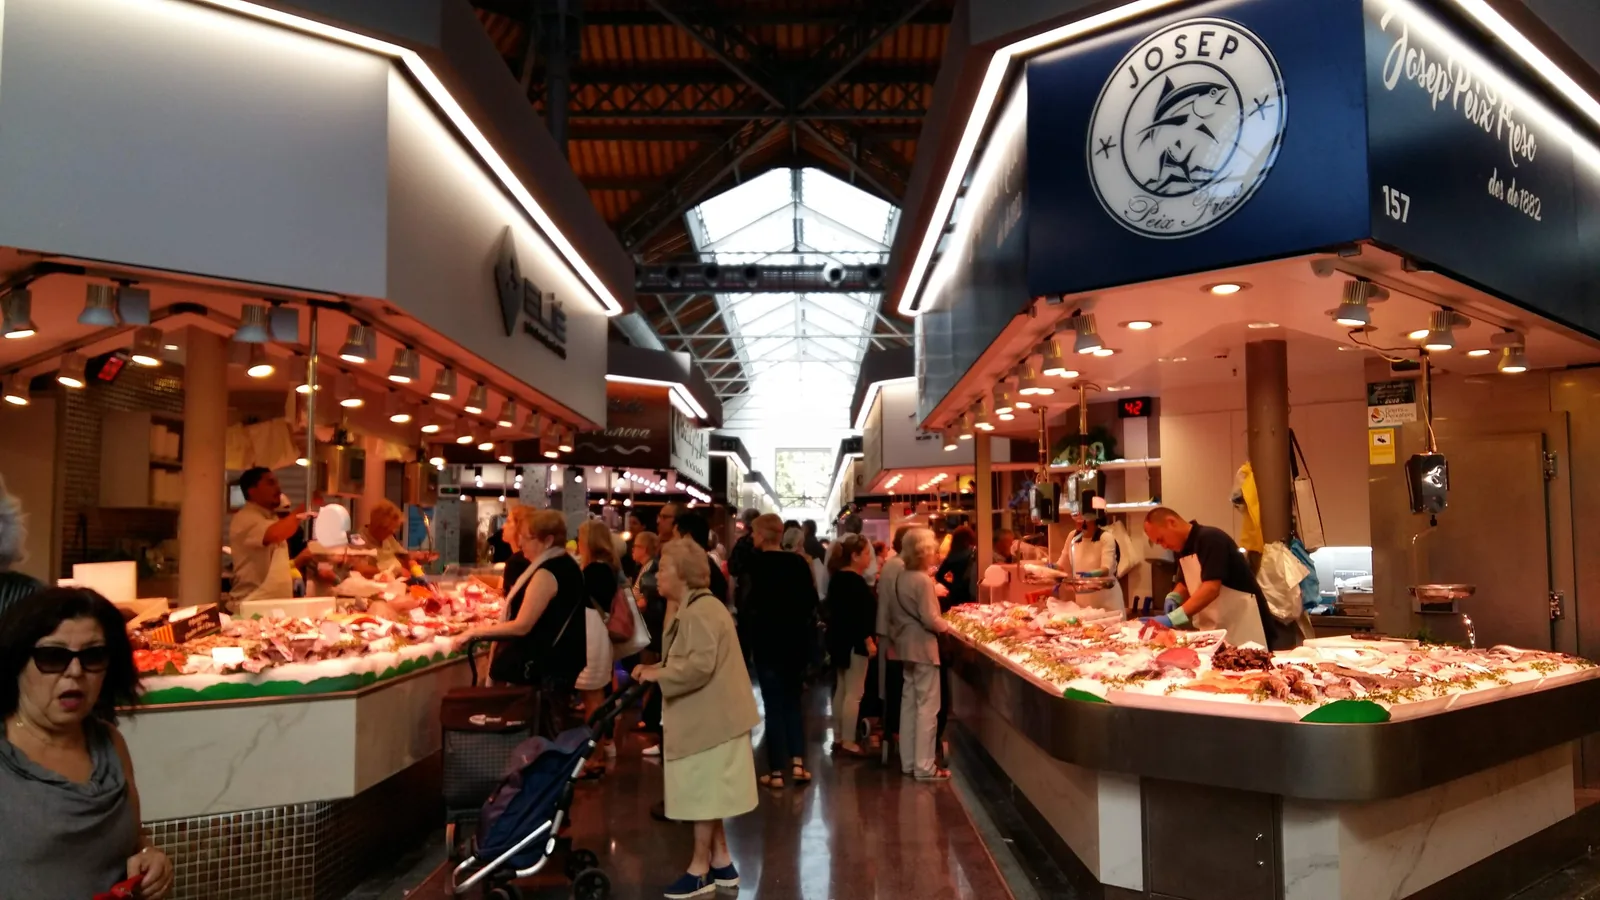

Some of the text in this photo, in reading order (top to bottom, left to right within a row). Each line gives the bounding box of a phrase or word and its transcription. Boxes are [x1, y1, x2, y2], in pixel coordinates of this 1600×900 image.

[1128, 31, 1239, 89] JOSEP
[1124, 195, 1174, 230] Peix
[1382, 185, 1410, 223] 157
[1519, 188, 1542, 221] 1882
[1124, 400, 1143, 415] 42
